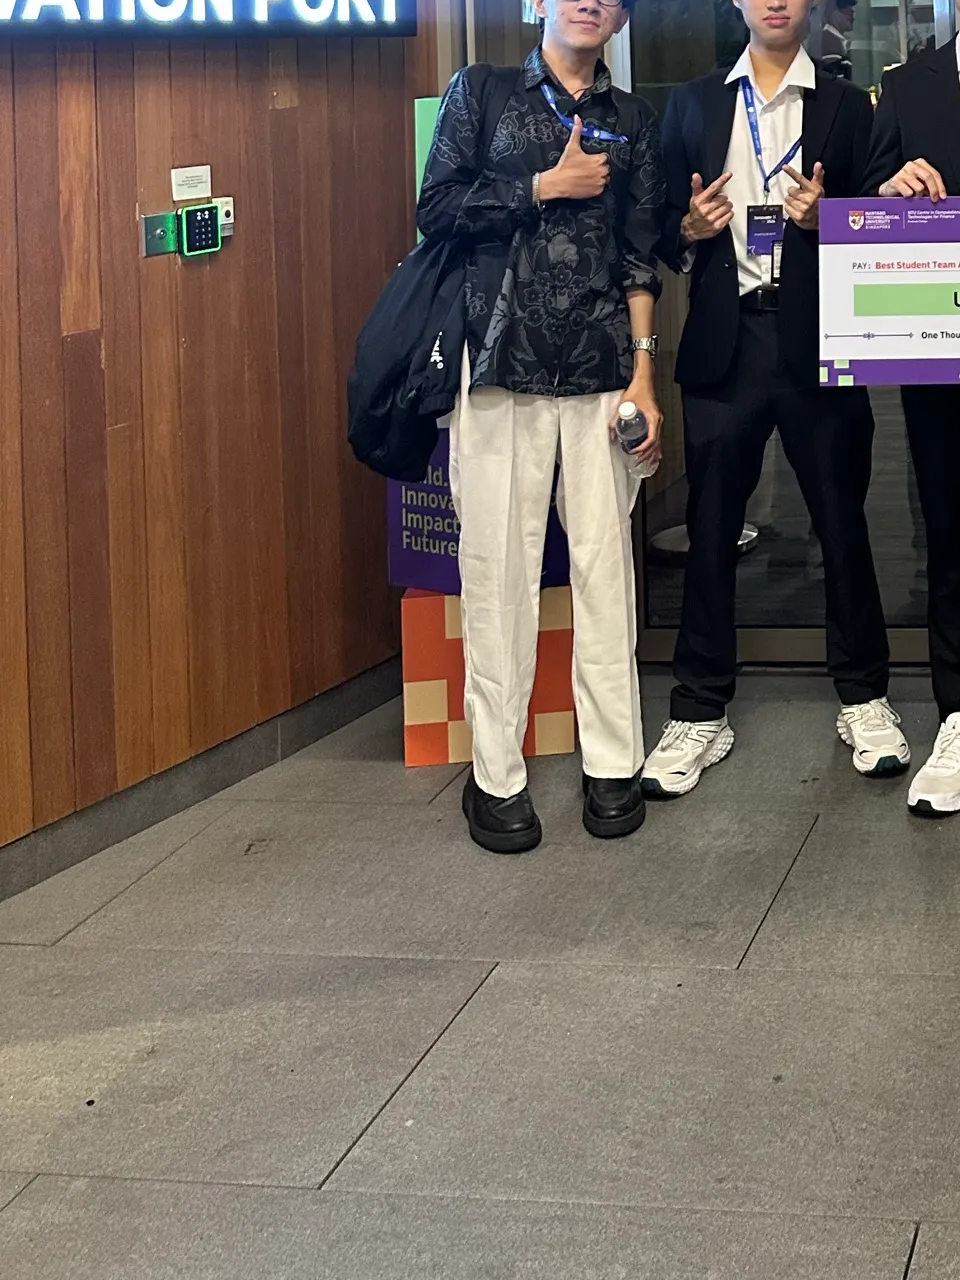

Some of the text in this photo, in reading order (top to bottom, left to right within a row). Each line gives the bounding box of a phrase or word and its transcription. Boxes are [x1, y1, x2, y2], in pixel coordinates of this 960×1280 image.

[852, 261, 871, 270] PAY:
[875, 261, 895, 270] Best
[896, 260, 931, 270] Student
[932, 260, 956, 269] Team
[921, 331, 938, 339] One
[402, 508, 461, 535] Impact
[402, 531, 458, 557] Future
